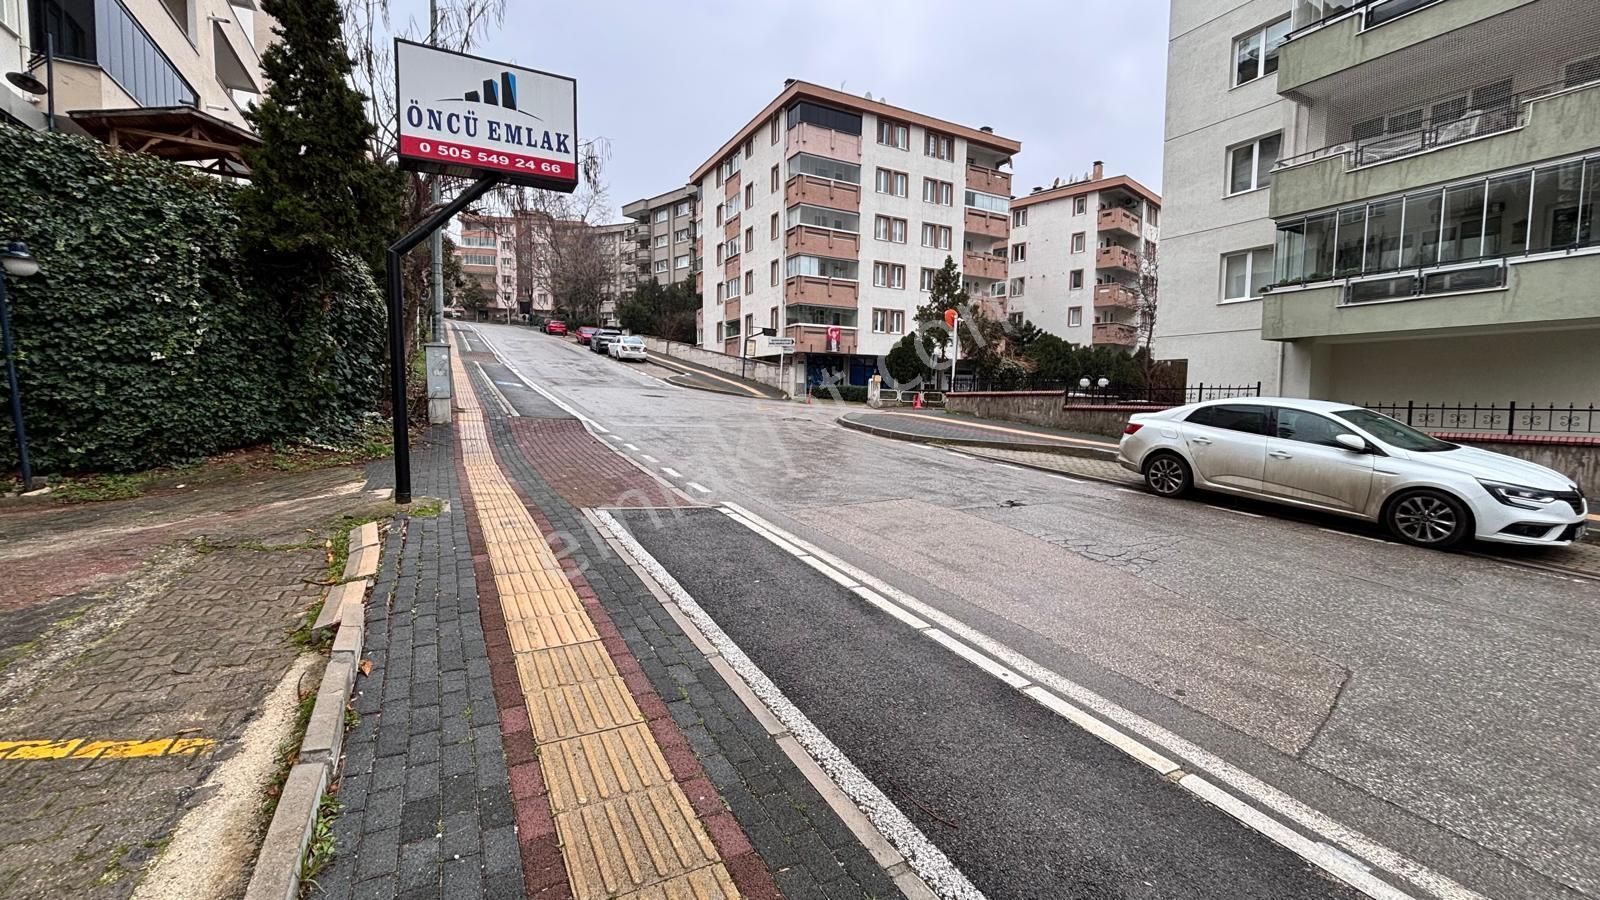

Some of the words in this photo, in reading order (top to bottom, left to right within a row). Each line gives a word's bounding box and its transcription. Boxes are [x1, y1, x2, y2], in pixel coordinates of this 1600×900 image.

[407, 99, 478, 137] ÖNCÜ
[487, 119, 571, 154] EMLAK
[419, 142, 431, 153] 0
[438, 145, 472, 160] 505
[477, 152, 510, 165] 549
[514, 158, 536, 170] 24
[540, 163, 561, 173] 66
